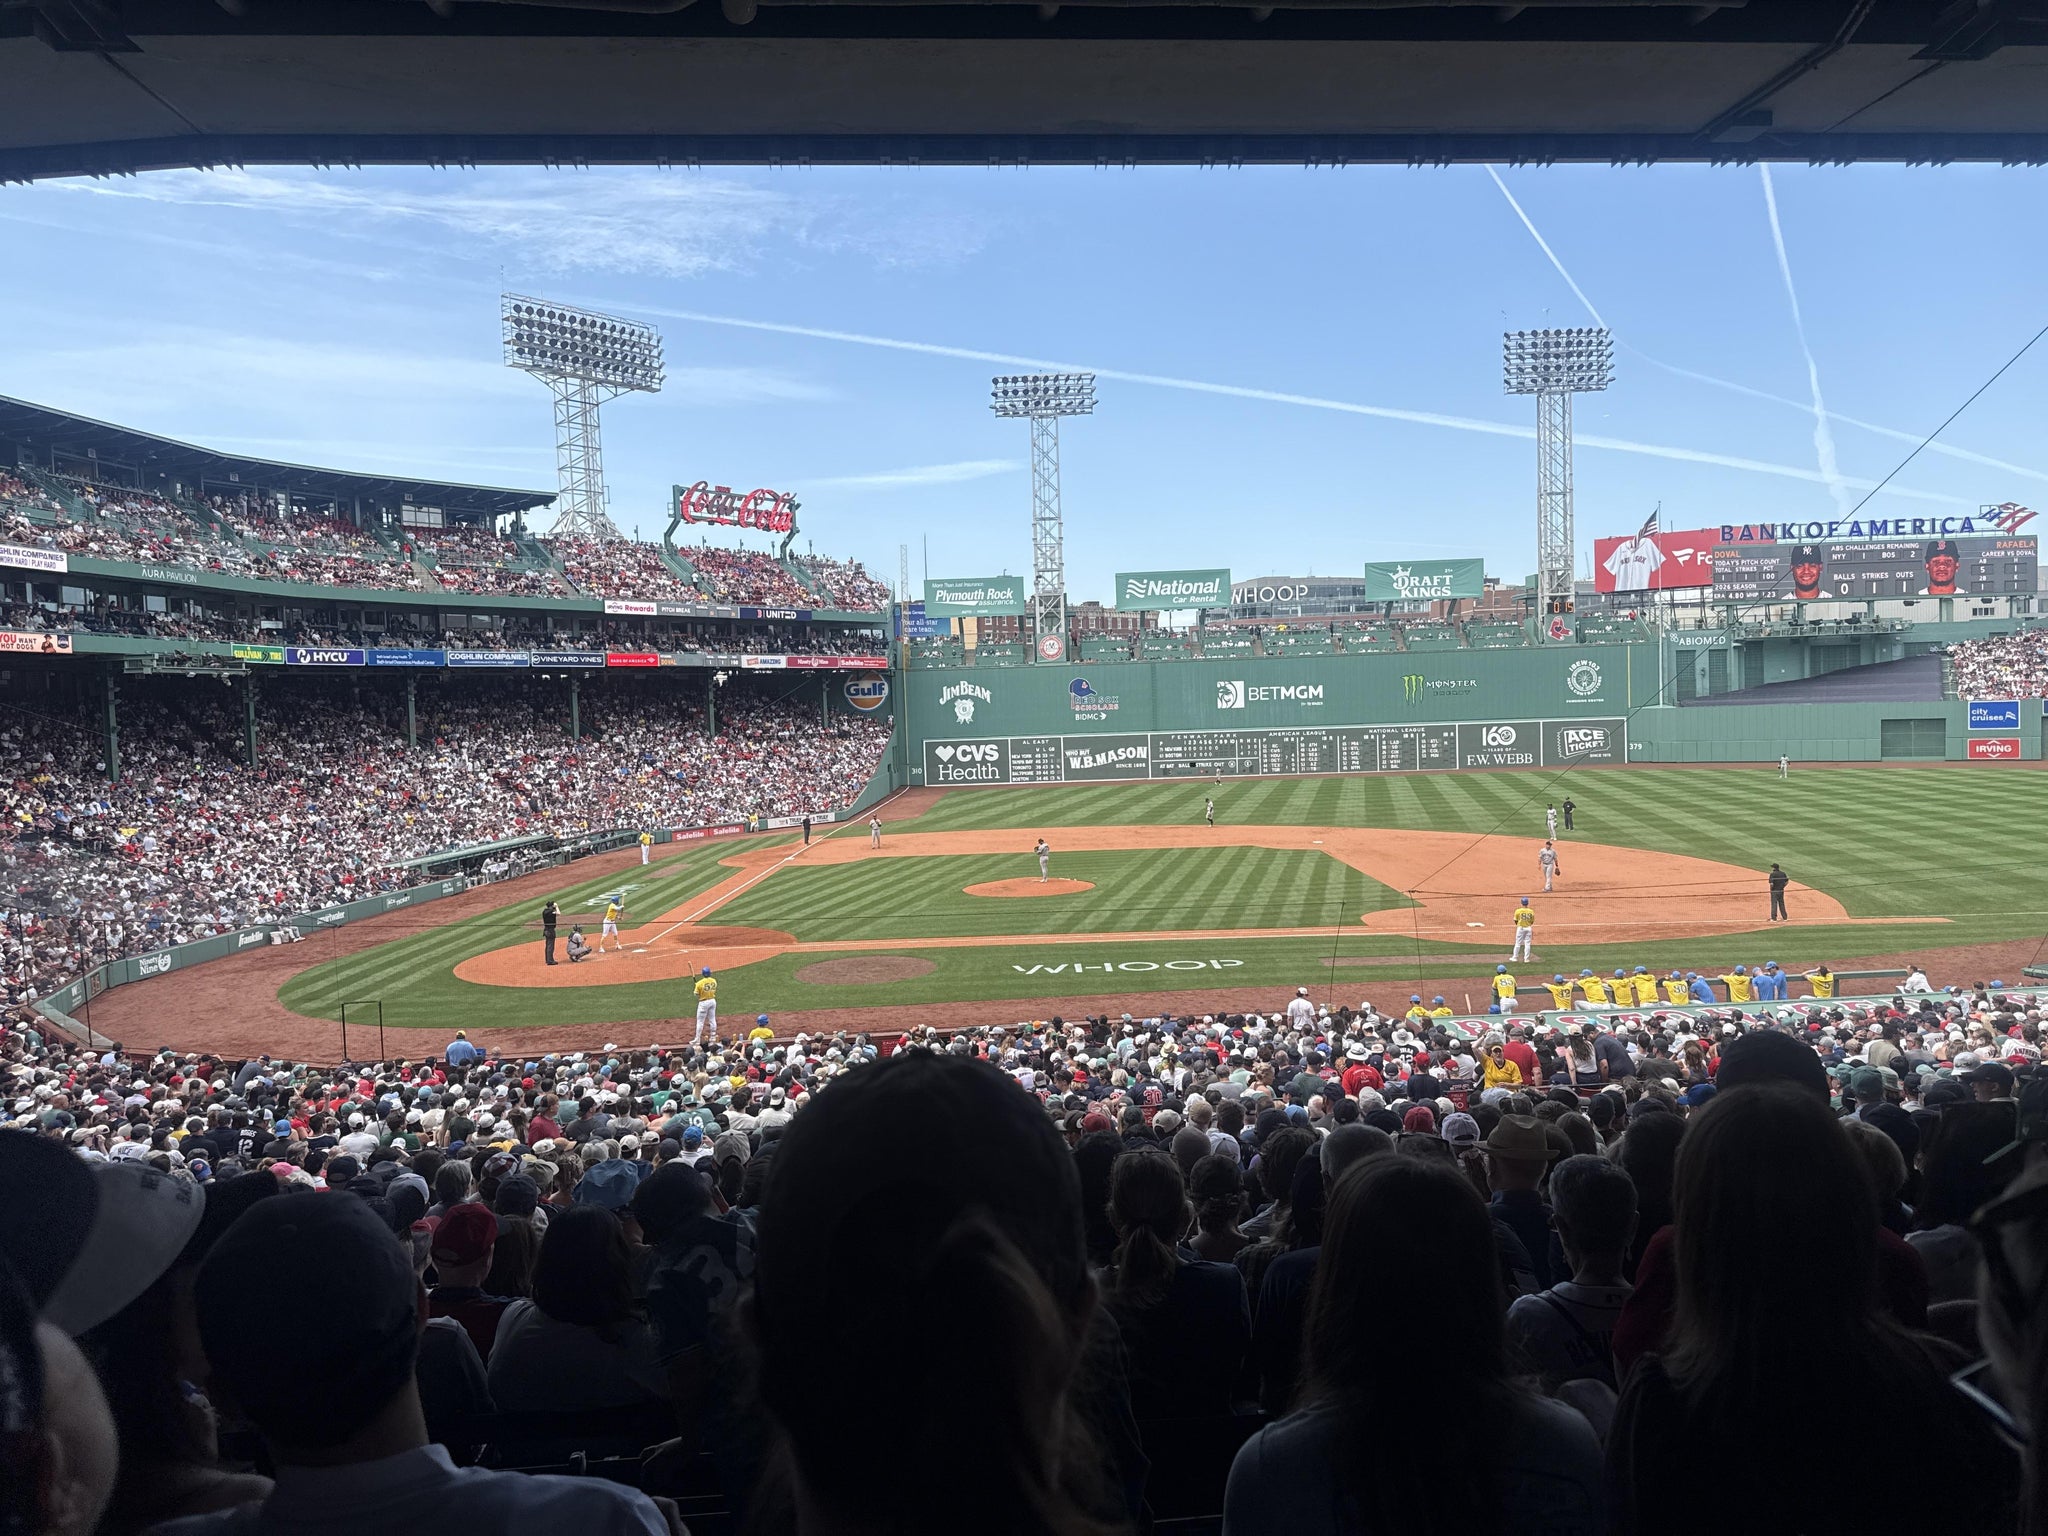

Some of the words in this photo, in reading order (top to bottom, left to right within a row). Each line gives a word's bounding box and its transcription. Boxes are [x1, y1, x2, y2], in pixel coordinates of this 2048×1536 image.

[1721, 522, 1796, 541] BANK
[1806, 520, 1840, 539] OF
[1848, 516, 1975, 537] AMERICA
[1845, 543, 1885, 551] CHALLENGES
[1996, 540, 2035, 549] RAFAELA
[21, 550, 64, 562] COMPANIES
[1714, 550, 1741, 559] DOVAL
[1881, 551, 1896, 559] BOS
[166, 570, 197, 583] PAVILION
[1392, 573, 1453, 590] DRAFT
[1147, 577, 1220, 596] National
[1400, 586, 1452, 598] KINGS
[1840, 583, 1849, 595] 0
[935, 588, 984, 603] Plymouth
[987, 587, 1014, 600] Rock
[1172, 596, 1187, 604] Car
[1190, 594, 1217, 603] Rental
[625, 604, 654, 612] Rewards
[1553, 602, 1560, 613] 0
[766, 609, 797, 619] UNITED
[0, 633, 17, 644] YOU
[1678, 635, 1726, 646] ABIOMED
[313, 651, 348, 662] HYCU
[580, 655, 602, 663] VINES
[846, 680, 885, 697] Gulf
[939, 684, 960, 705] JIM
[959, 680, 992, 704] BEAM
[1248, 684, 1323, 701] BETMGM
[1075, 703, 1119, 711] SCHOLARS
[1971, 707, 1988, 716] city
[1075, 713, 1099, 721] BIDMC
[1567, 728, 1605, 743] ACE
[1568, 740, 1605, 752] TICKET
[1975, 745, 2012, 753] IRVING
[956, 744, 999, 762] CVS
[1466, 754, 1490, 767] F.W.
[1494, 753, 1533, 765] WEBB
[911, 767, 922, 775] 310
[938, 763, 1000, 781] Health
[676, 831, 705, 840] Safelite
[713, 826, 740, 836] Safelite
[238, 931, 264, 947] Franklin
[139, 957, 158, 967] Ninety
[1012, 959, 1245, 975] WHOOP
[139, 964, 158, 976] Nine
[703, 982, 717, 992] 52
[1143, 1088, 1162, 1105] 30
[238, 1138, 253, 1155] 12
